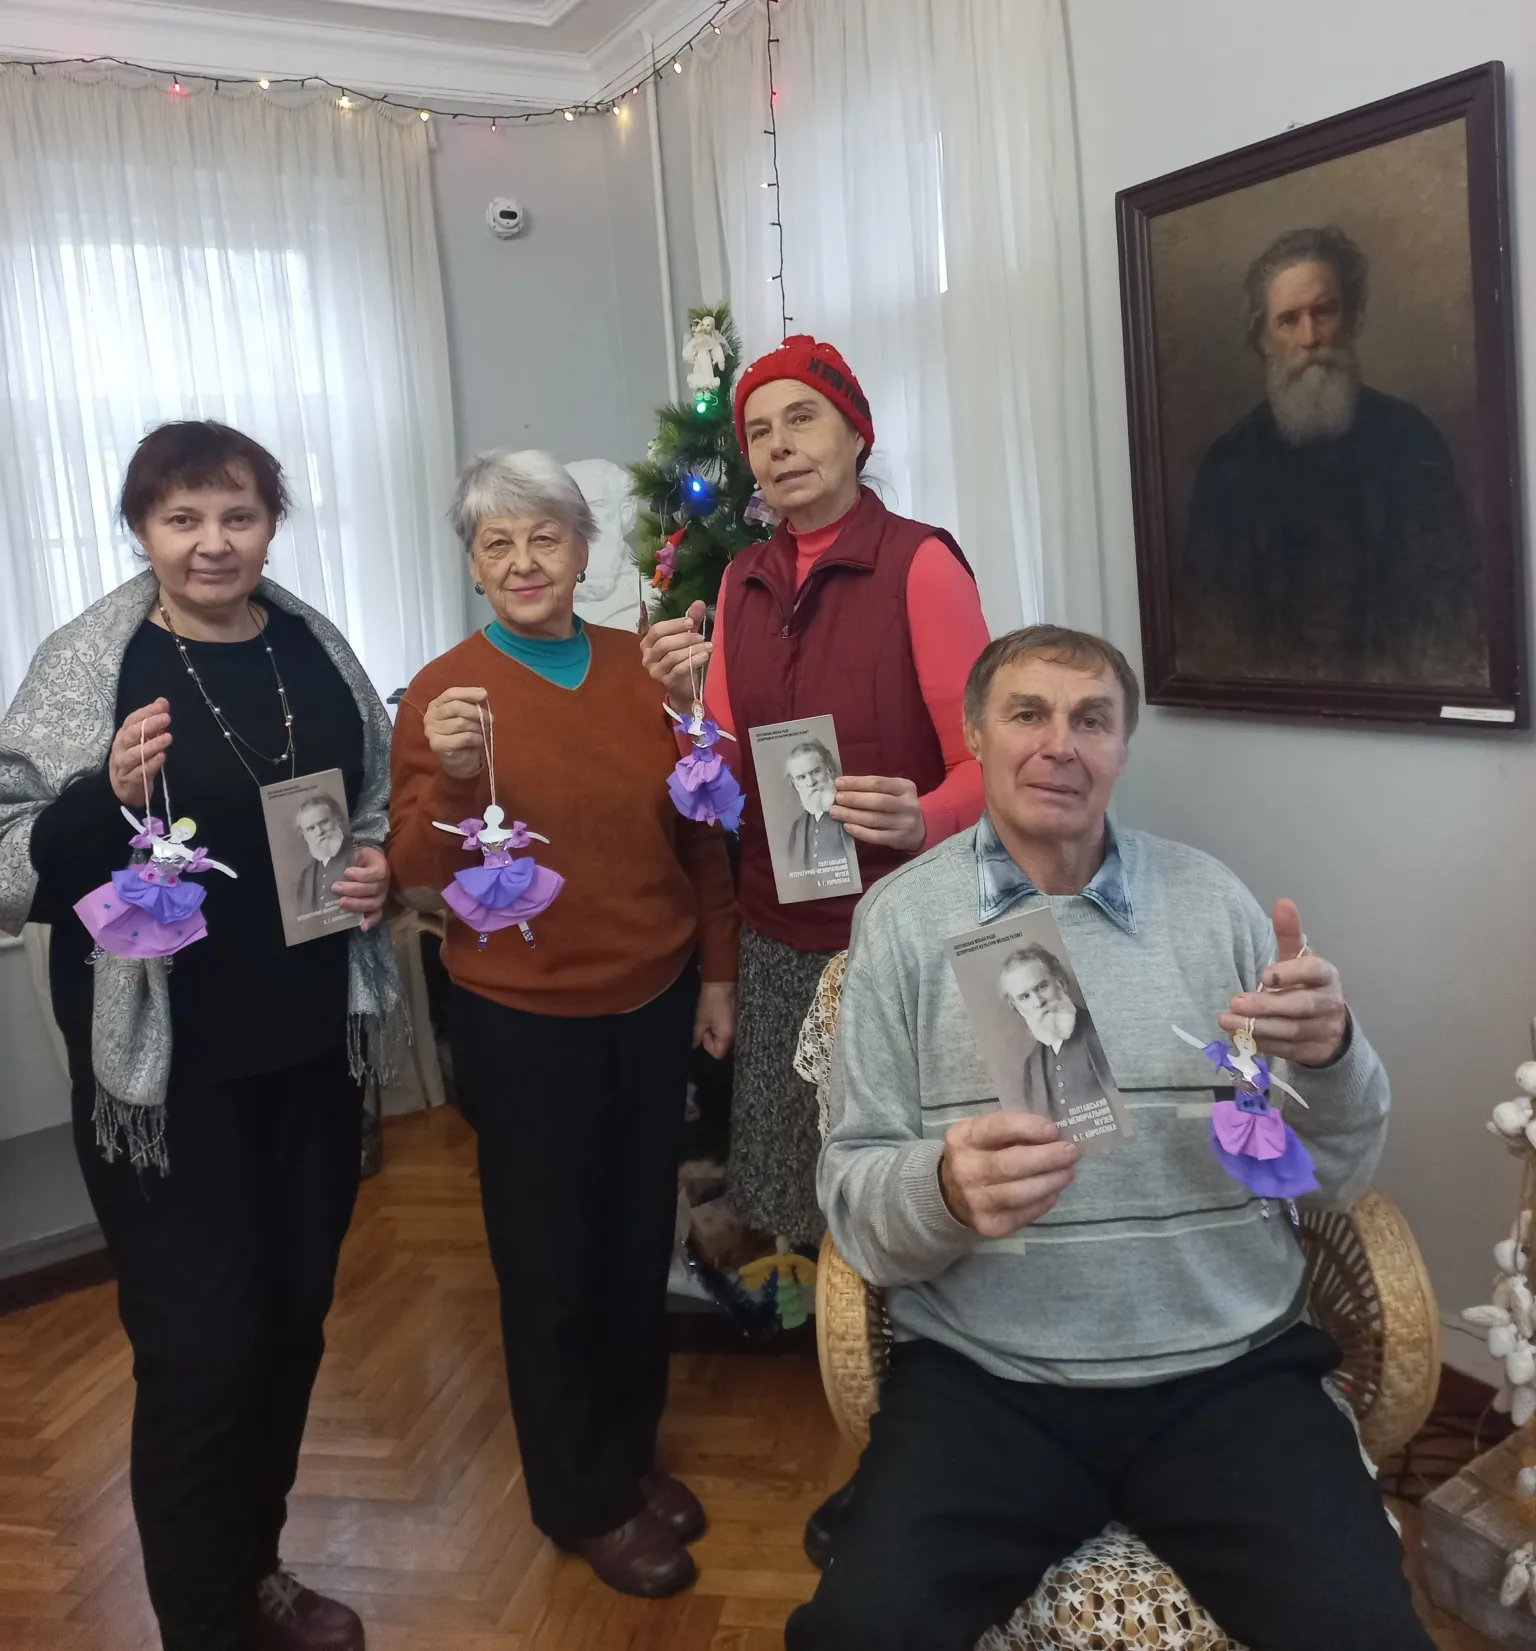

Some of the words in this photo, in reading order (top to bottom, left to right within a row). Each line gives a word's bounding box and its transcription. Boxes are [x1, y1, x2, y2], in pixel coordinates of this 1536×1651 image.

[1068, 1097, 1108, 1116] ПОЛТАВСЬКИЙ
[1056, 1106, 1111, 1128] РНО-МЕМОРІАЛЬНИЙ
[1094, 1114, 1115, 1127] МУЗЕЙ
[1085, 1123, 1118, 1139] КОРОЛЕНКА
